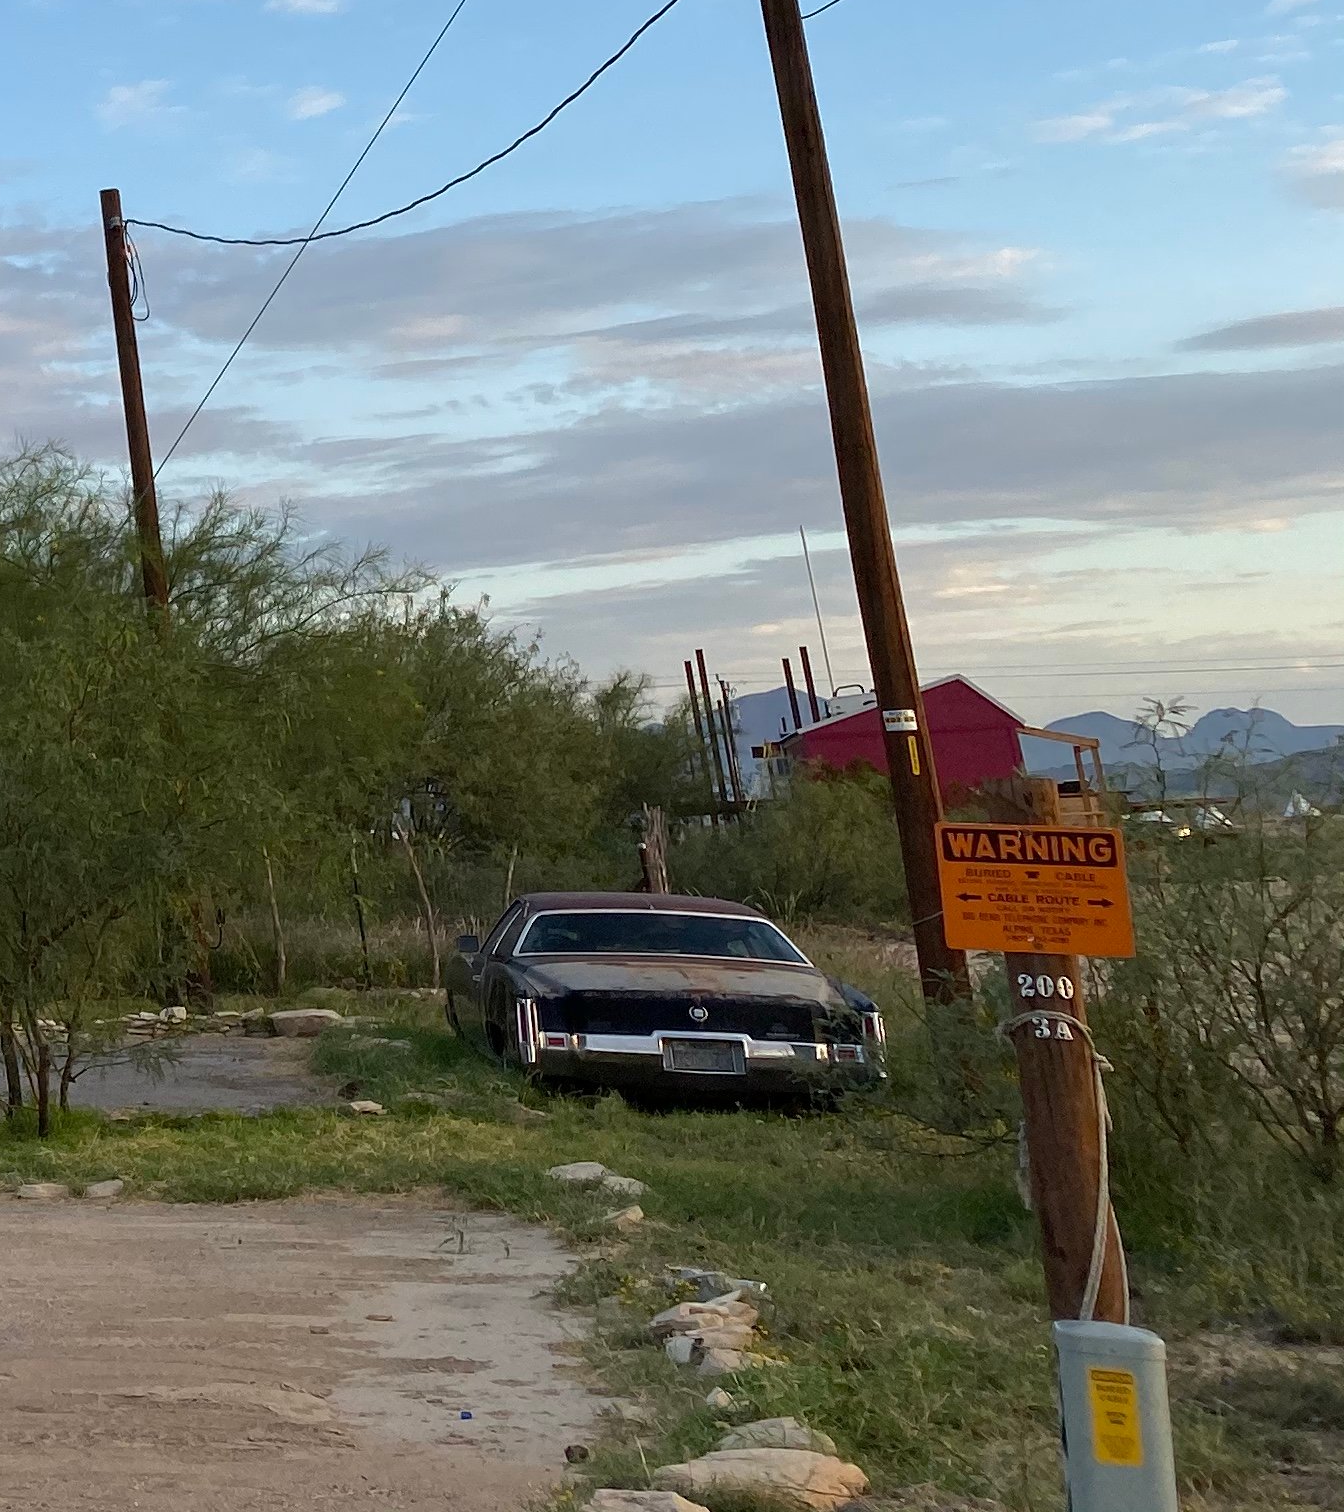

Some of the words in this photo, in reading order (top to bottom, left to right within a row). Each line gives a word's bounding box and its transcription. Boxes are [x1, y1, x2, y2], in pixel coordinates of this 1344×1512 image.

[947, 832, 1113, 863] WARNING
[965, 868, 1011, 878] BURIED
[1055, 871, 1096, 882] CABLE
[987, 893, 1030, 904] CABLE
[1036, 894, 1080, 906] ROUTE
[1017, 974, 1074, 999] 200
[1032, 1017, 1074, 1041] 3A
